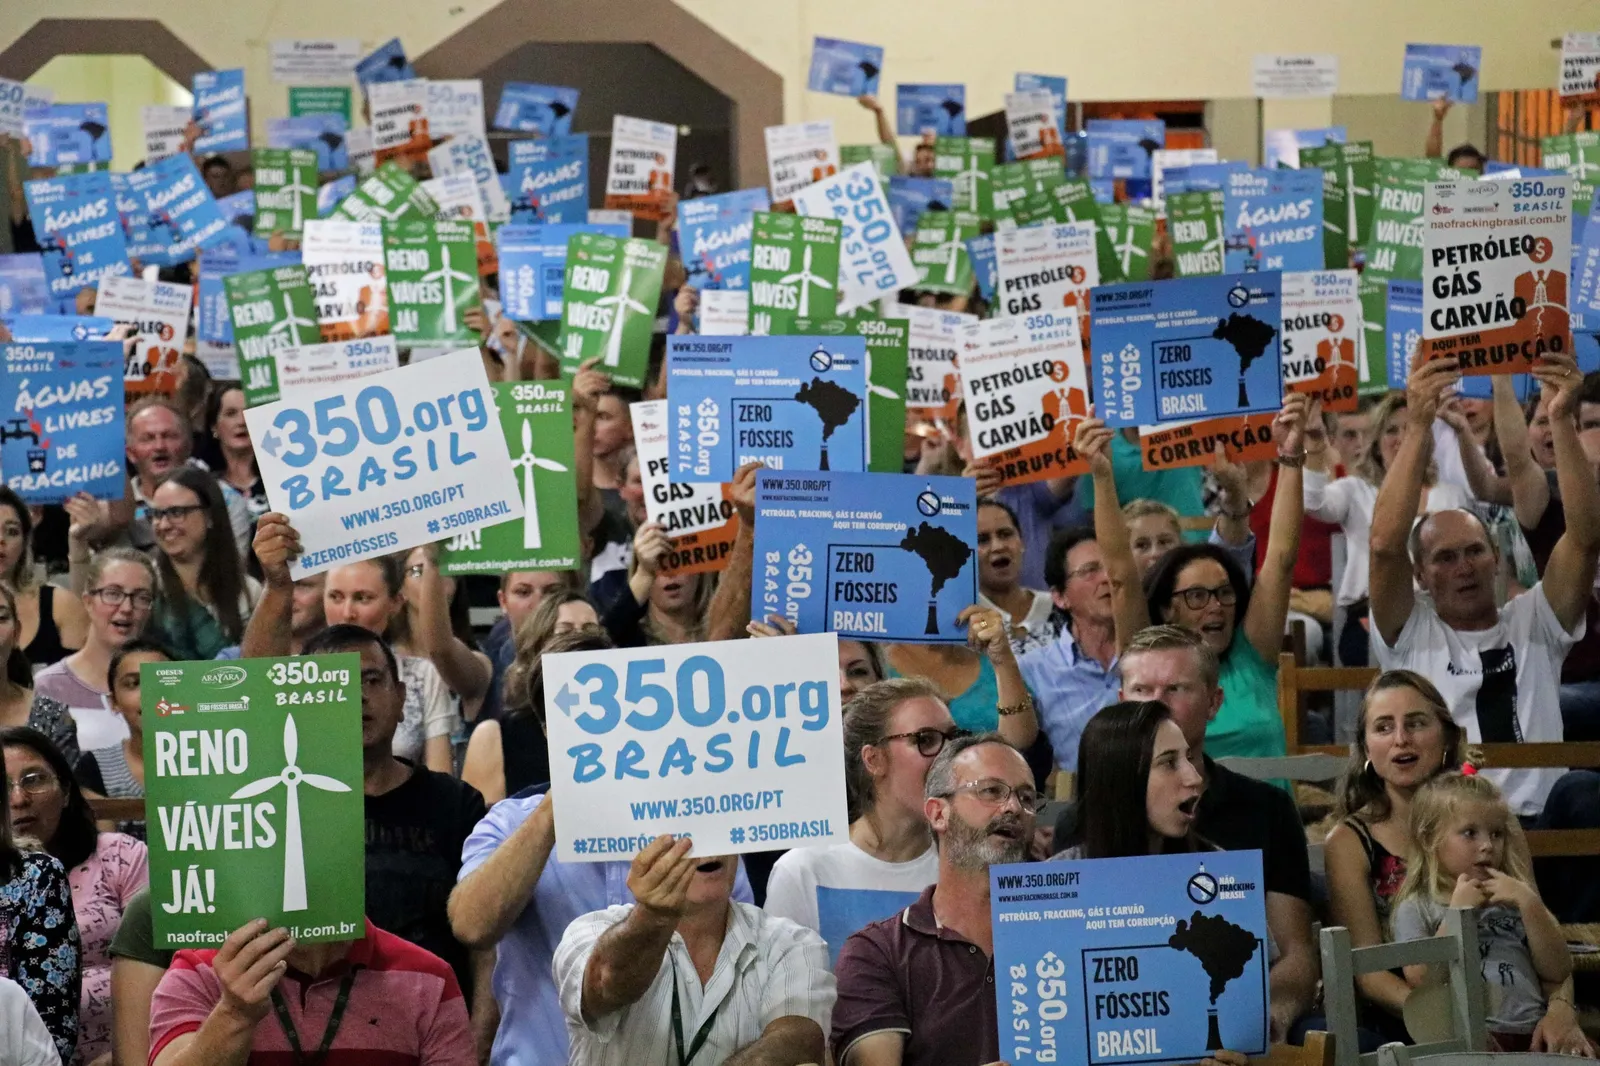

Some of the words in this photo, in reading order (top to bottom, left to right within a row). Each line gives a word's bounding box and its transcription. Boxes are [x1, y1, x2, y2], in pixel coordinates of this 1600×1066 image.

[520, 161, 583, 193] ÁGUAS
[1511, 181, 1566, 198] 350.org
[1379, 186, 1423, 214] RENO
[1513, 200, 1563, 213] BRASIL
[44, 198, 109, 233] ÁGUAS
[1236, 198, 1314, 229] ÁGUAS
[1430, 213, 1567, 229] naofrackingbrasil.com.br
[67, 221, 116, 247] LIVRES
[845, 176, 898, 291] 350.org
[1055, 226, 1091, 240] 350.org
[1173, 219, 1208, 243] RENO
[1259, 225, 1317, 247] LIVRES
[387, 249, 430, 271] RENO
[753, 244, 791, 272] RENO
[1177, 249, 1220, 276] VÁVEIS
[1266, 255, 1284, 268] DE
[1369, 247, 1397, 272] JÁ!
[1432, 234, 1536, 268] PETRÓLEO
[570, 264, 610, 294] RENO
[1005, 264, 1074, 293] PETRÓLEO
[1313, 274, 1353, 287] 350.org
[1432, 267, 1483, 300] GÁS
[390, 279, 444, 304] VÁVEIS
[752, 279, 799, 310] VÁVEIS
[1007, 292, 1042, 316] GÁS
[232, 299, 275, 327] RENO
[394, 308, 419, 332] JÁ!
[568, 300, 613, 332] VÁVEIS
[1026, 314, 1073, 330] 350.org
[1430, 292, 1527, 332] CARVÃO
[859, 320, 903, 337] 350.org
[1030, 330, 1072, 342] BRASIL
[5, 346, 54, 363] 350.org
[345, 341, 391, 358] 350.org
[672, 343, 733, 354] WWW.350.ORG/PT
[1159, 345, 1191, 364] ZERO
[1432, 338, 1457, 352] AQUI
[1460, 333, 1481, 346] TEM
[6, 362, 53, 374] BRASIL
[246, 363, 272, 390] JÁ!
[970, 358, 1054, 396] PETRÓLEO
[1160, 366, 1213, 389] FÓSSEIS
[14, 376, 113, 413] ÁGUAS
[514, 384, 565, 402] 350.org
[1101, 353, 1117, 419] BRASIL
[1119, 344, 1142, 421] 350.org
[516, 403, 563, 414] BRASIL
[739, 404, 772, 422] ZERO
[974, 392, 1016, 422] GÁS
[1162, 393, 1208, 415] BRASIL
[45, 406, 117, 435] LIVRES
[272, 385, 488, 468] 350.org
[978, 411, 1055, 450] CARVÃO
[678, 405, 691, 473] BRASIL
[694, 400, 720, 476] 350.org
[740, 427, 794, 448] FÓSSEIS
[1147, 424, 1272, 466] CORRUPÇÃO
[56, 444, 77, 460] DE
[7, 460, 120, 492] FRACKING
[280, 432, 477, 511] BRASIL
[762, 478, 832, 492] WWW.350.ORG/PT
[340, 483, 465, 531] WWW.350.ORG/PT
[941, 496, 954, 504] NÃO
[941, 502, 970, 510] FRACKING
[941, 508, 963, 516] BRASIL
[761, 508, 797, 519] PETRÓLEO,
[798, 510, 834, 520] FRACKING,
[835, 509, 849, 519] GÁS
[856, 509, 882, 520] CARVÃO
[833, 521, 850, 529] AQUI
[851, 522, 866, 530] TEM
[867, 521, 907, 532] CORRUPÇÃO
[301, 531, 399, 570] #ZEROFÓSSEIS
[835, 552, 874, 573] ZERO
[448, 556, 575, 572] naofrackingbrasil.com.br
[786, 549, 813, 628] 350.or
[834, 579, 898, 604] FÓSSEIS
[833, 610, 887, 634] BRASIL
[156, 669, 184, 677] COESUS
[201, 672, 240, 684] ARAYARA
[271, 660, 350, 687] 350.org
[275, 688, 348, 706] BRASIL
[573, 655, 830, 734] 350.org
[155, 728, 249, 777] RENO
[567, 726, 806, 784] BRASIL
[630, 790, 784, 821] WWW.350.ORG/PT
[157, 801, 277, 851] VÁVEIS
[161, 864, 216, 915] JÁ!
[997, 872, 1081, 890] WWW.350.ORG/PT
[1219, 875, 1235, 884] NÃO
[1219, 882, 1255, 892] FRACKING
[998, 891, 1079, 902] WWW.NAOFRACKINGBRASIL.COM.BR
[1219, 889, 1246, 900] BRASIL
[999, 910, 1042, 923] PETRÓLEO,
[1043, 908, 1086, 921] FRACKING,
[1088, 906, 1104, 917] GÁS
[1105, 907, 1111, 916] E
[1112, 903, 1145, 916] CARVÃO
[1086, 919, 1107, 930] AQUI
[1108, 918, 1125, 929] TEM
[1126, 914, 1175, 928] CORRUPÇÃO
[167, 922, 356, 943] naofracil.com.br
[1092, 955, 1139, 983] ZERO
[1010, 963, 1032, 1061] BRASIL
[1035, 954, 1068, 1063] 350.org
[1095, 990, 1170, 1020] FÓSSEIS
[1097, 1028, 1162, 1058] BRASIL
